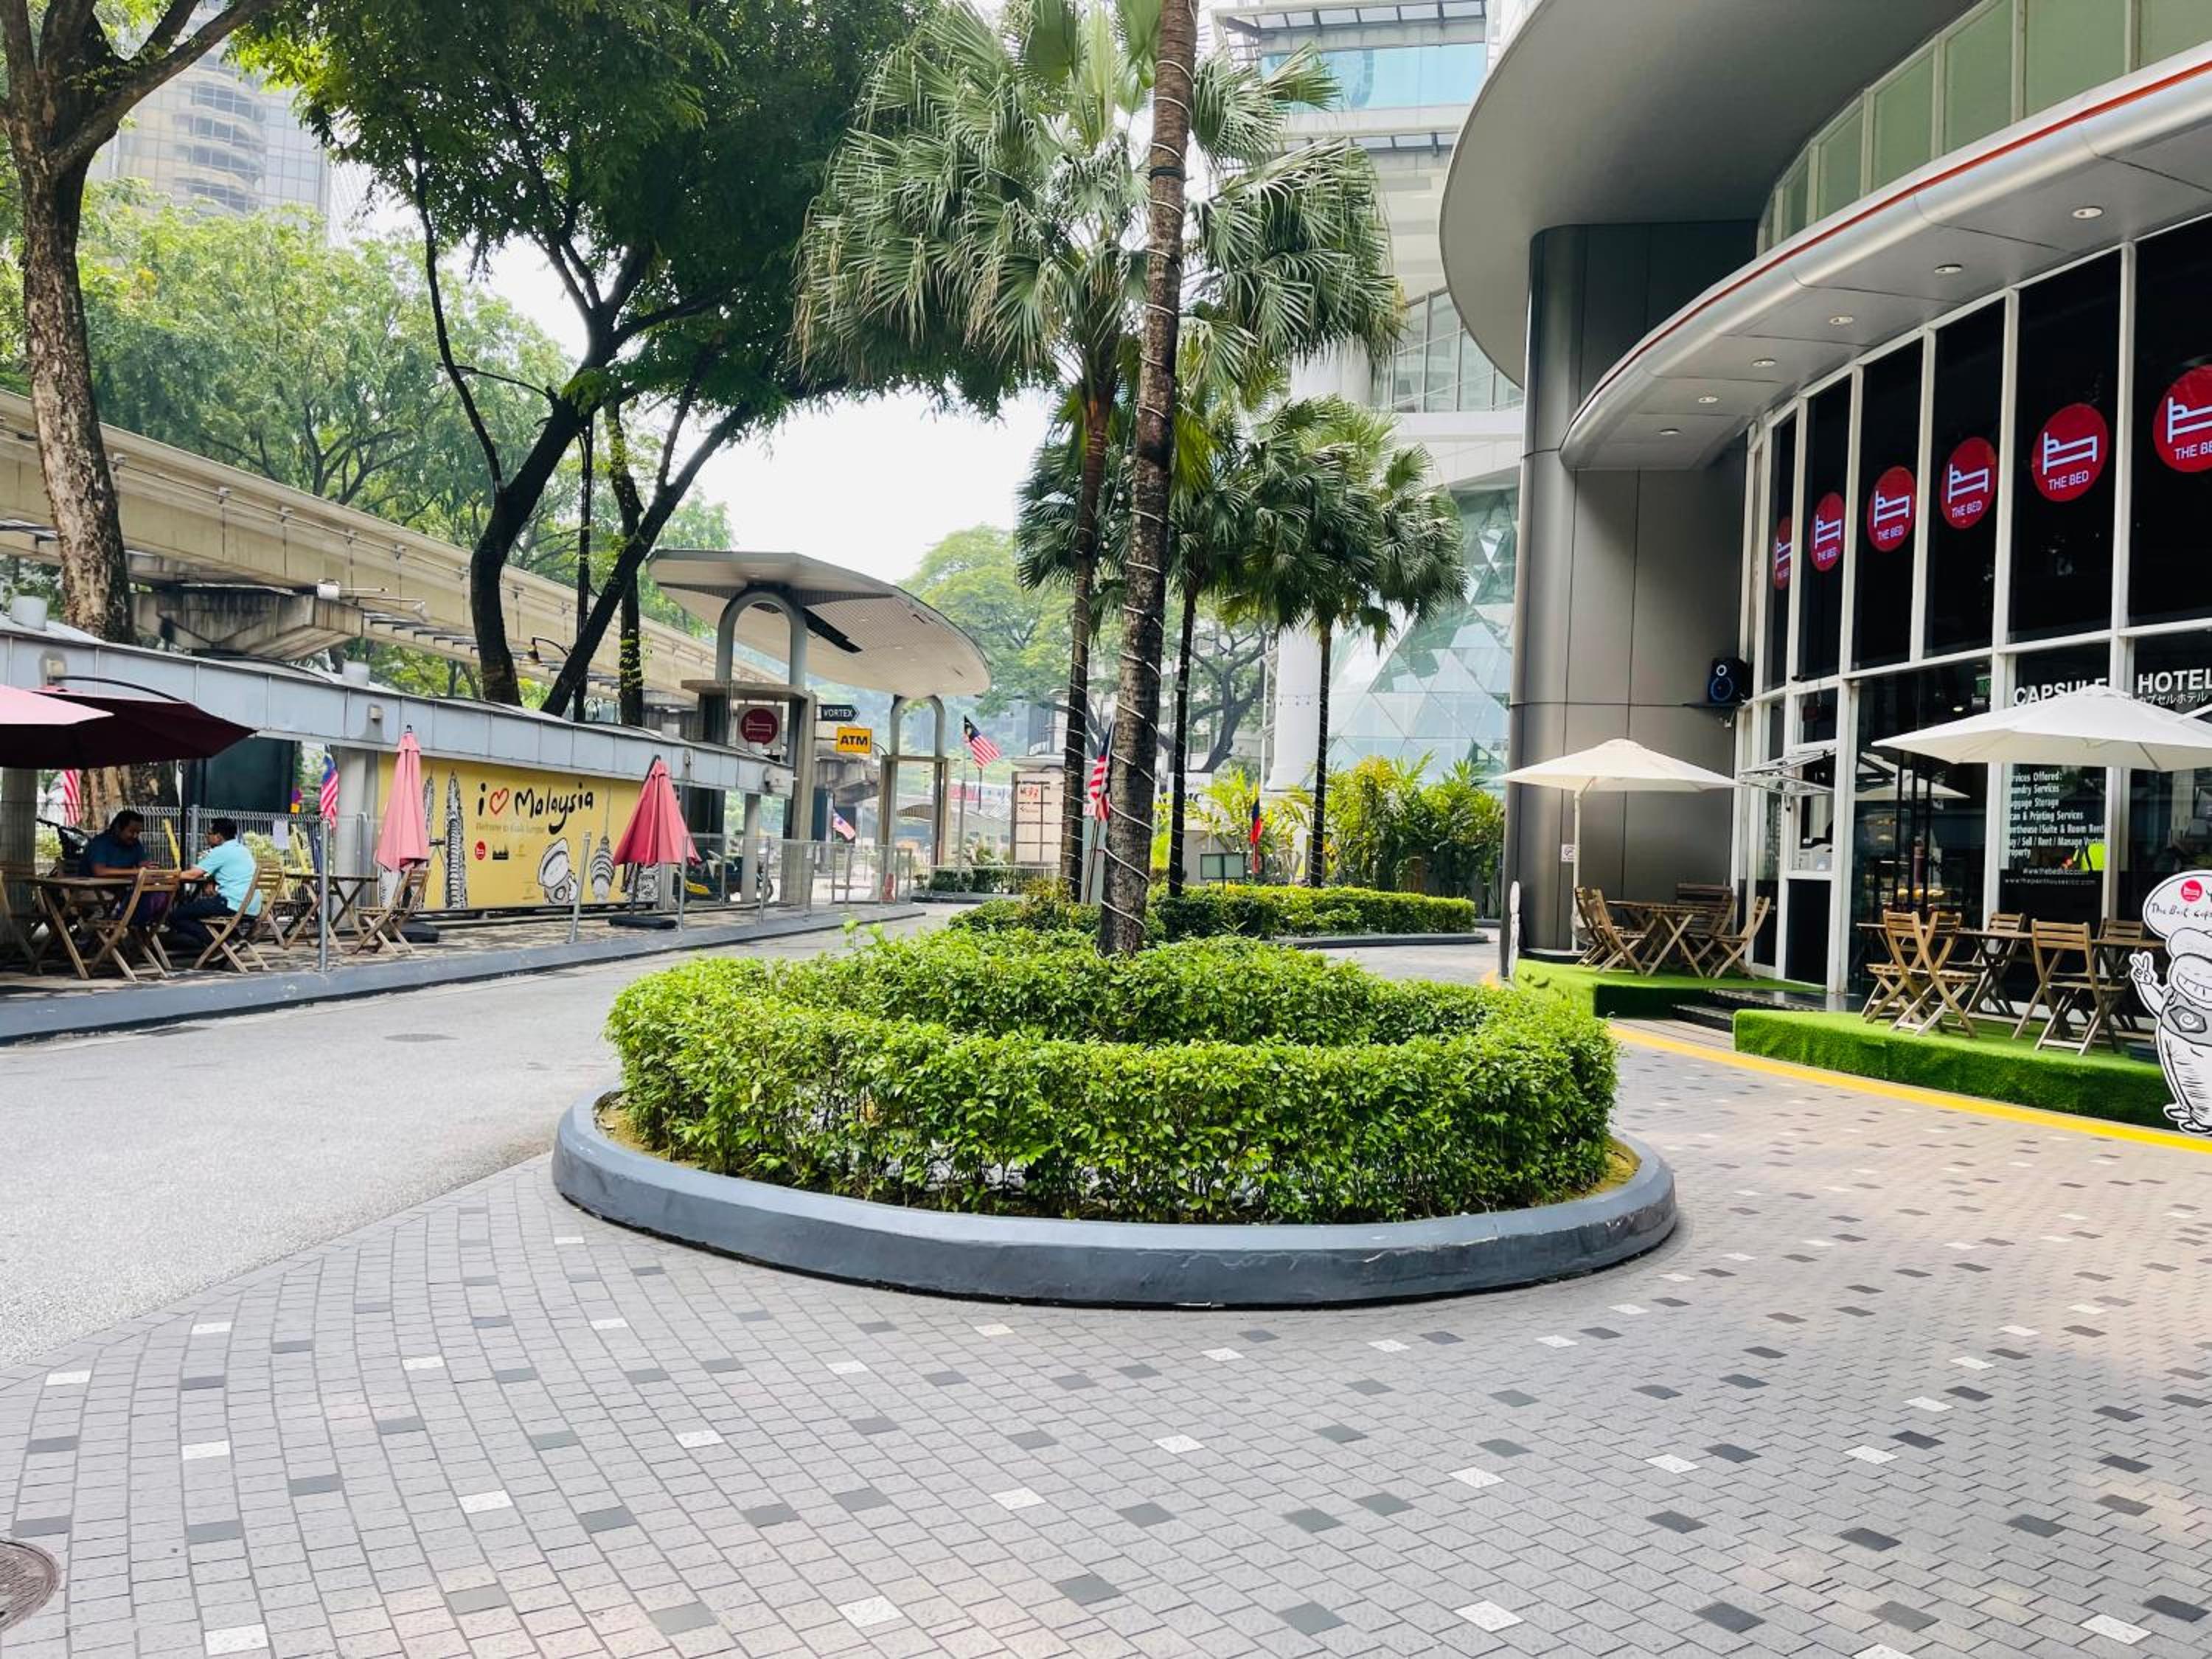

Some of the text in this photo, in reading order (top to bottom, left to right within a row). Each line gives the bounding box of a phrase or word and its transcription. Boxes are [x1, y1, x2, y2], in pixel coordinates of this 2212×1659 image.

[2174, 444, 2197, 460] THE
[2048, 470, 2089, 490] THE BED
[1952, 501, 1983, 518] THE BED
[1877, 525, 1905, 541] THE BED
[824, 709, 853, 717] VORTEX
[840, 735, 868, 746] ATM
[2033, 782, 2059, 794] Services
[478, 782, 594, 835] i Malaysia
[2034, 798, 2059, 809] Storage
[2029, 811, 2055, 822] Printing
[2056, 810, 2084, 821] Services
[2067, 824, 2087, 834] Room
[2022, 836, 2032, 846] Sell
[2038, 836, 2052, 846] Rent
[2057, 836, 2082, 848] Manage
